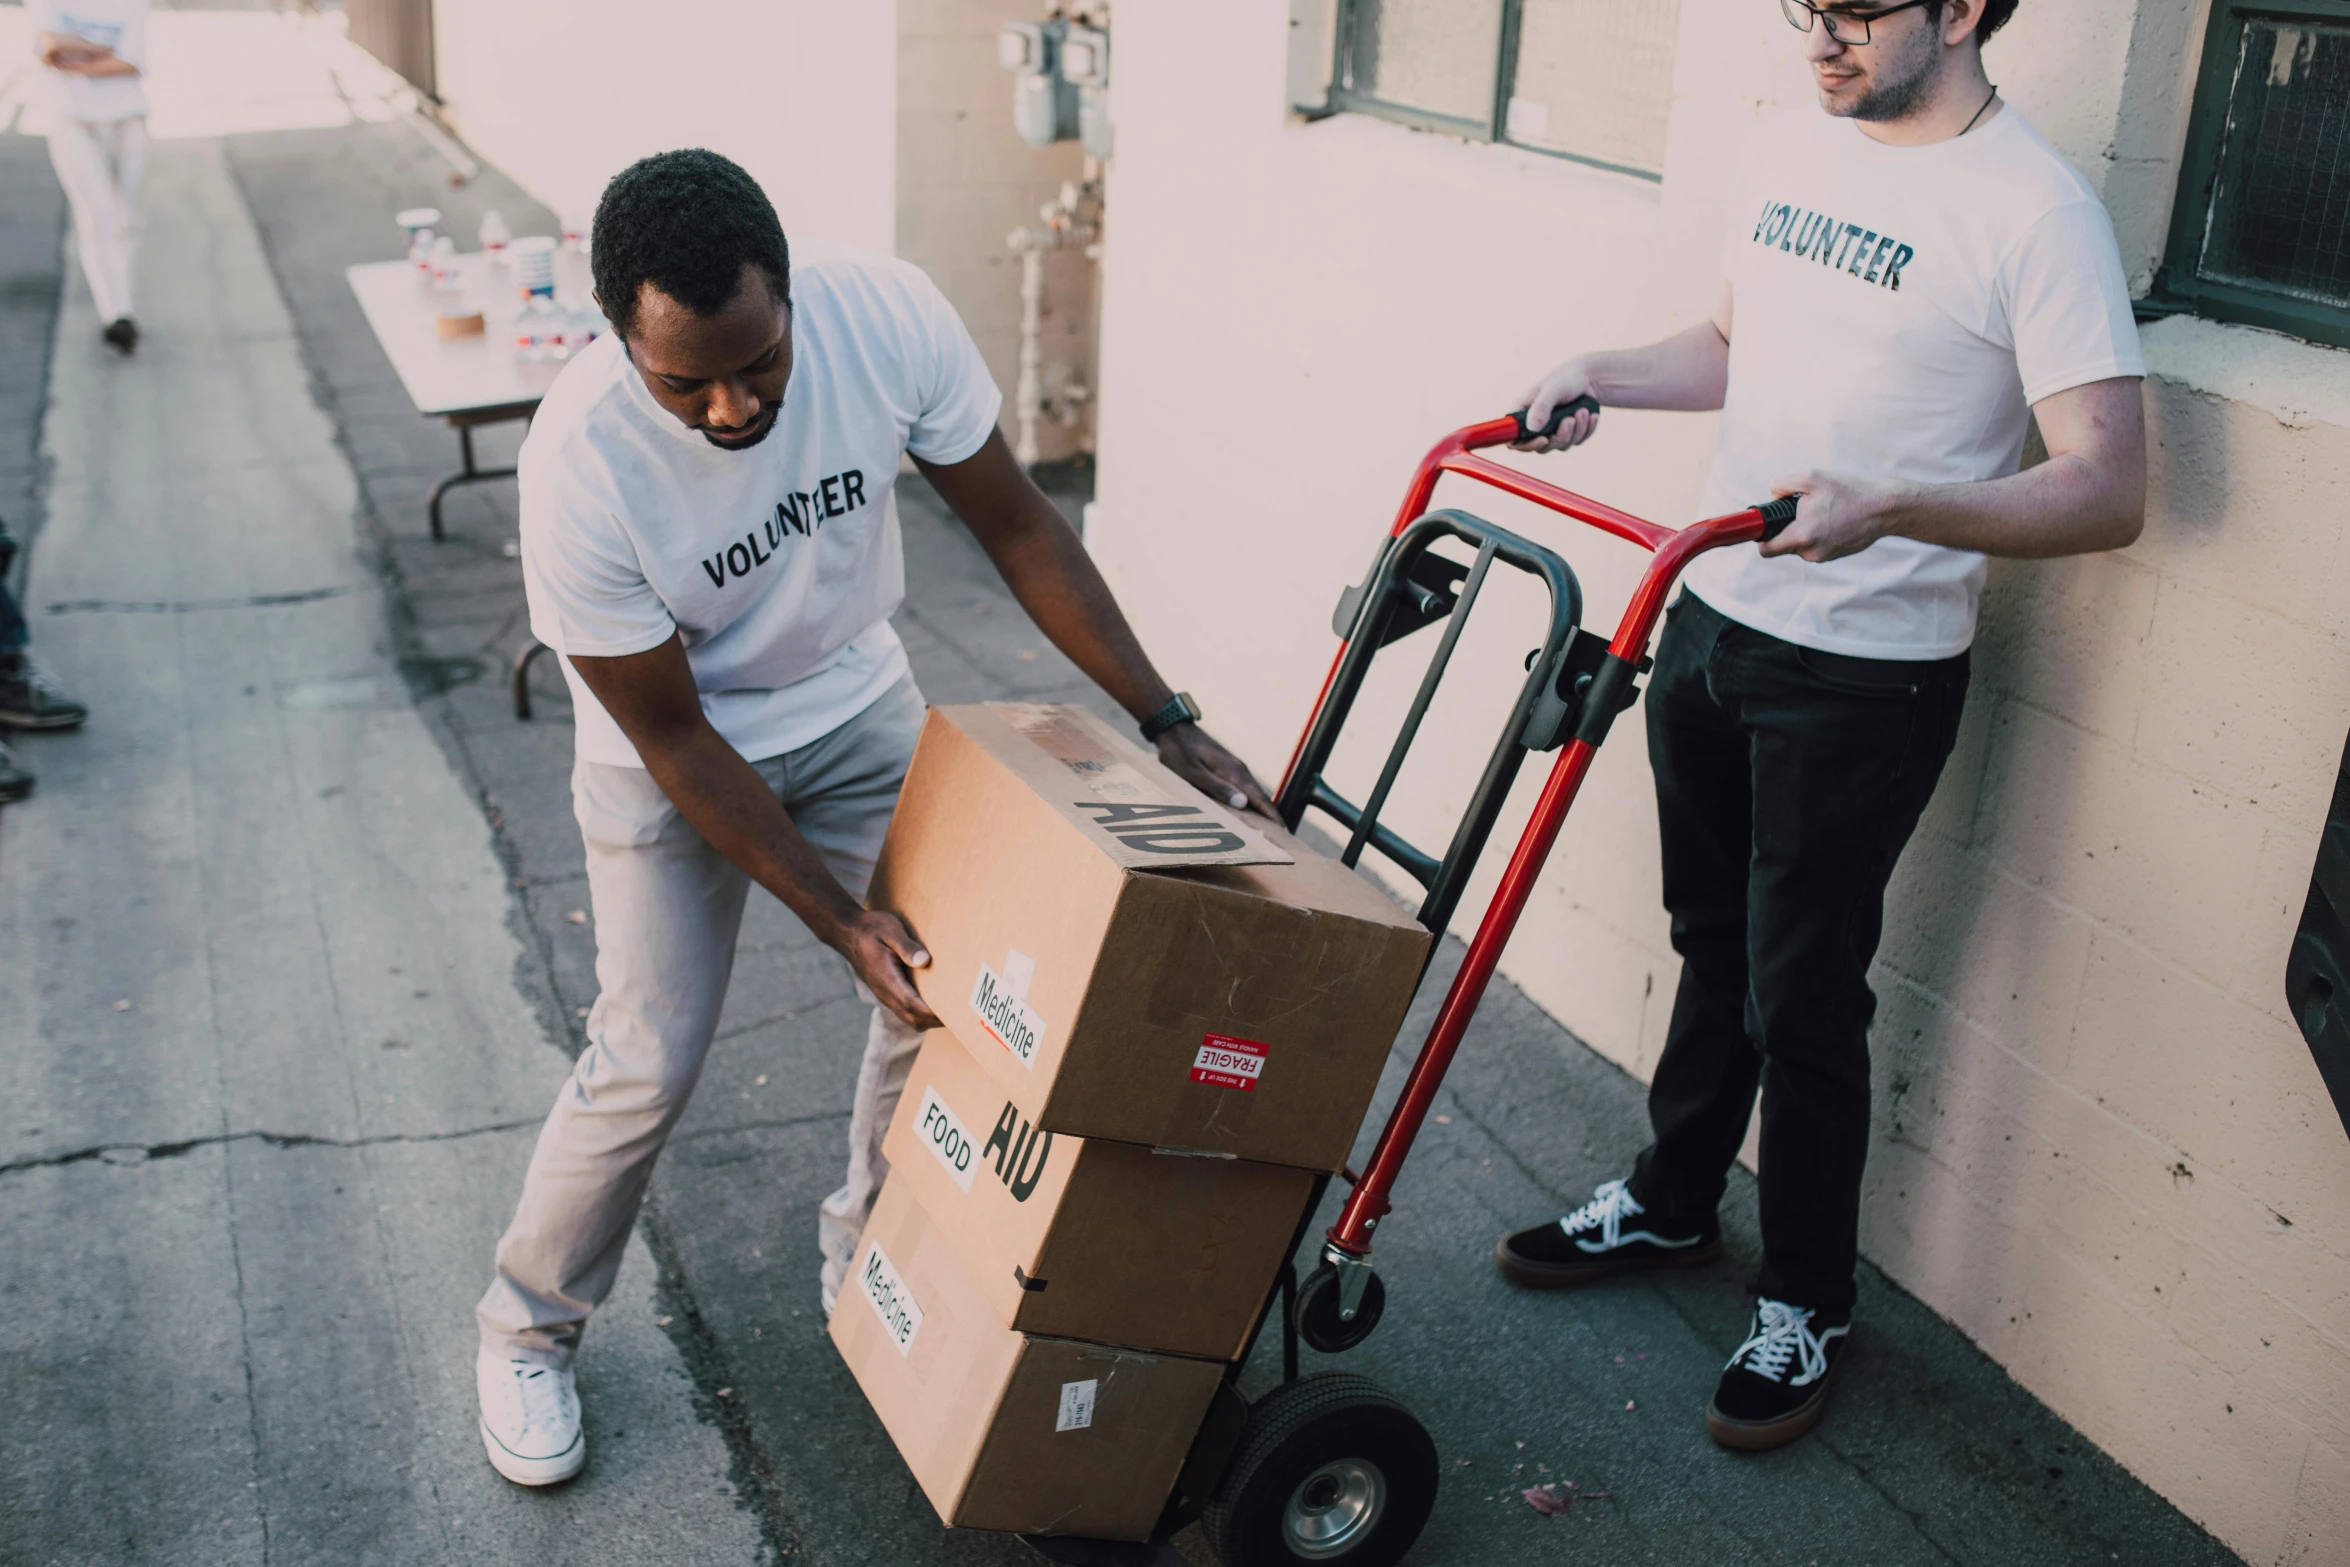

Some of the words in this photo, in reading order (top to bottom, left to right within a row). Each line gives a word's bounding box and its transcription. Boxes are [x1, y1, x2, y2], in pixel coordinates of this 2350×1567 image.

[1753, 200, 1914, 291] VOLUNTEER
[702, 469, 866, 589] VOLUNTEER
[1073, 802, 1246, 854] AID
[975, 972, 1034, 1059] Medicine
[1212, 1039, 1226, 1047] CARE
[1201, 1050, 1258, 1073] FRAGILE
[1216, 1075, 1227, 1083] SIDE
[1239, 1044, 1259, 1053] HANDLE
[1226, 1077, 1238, 1085] THIS
[923, 1102, 971, 1172] FOOD
[982, 1100, 1053, 1203] AID
[862, 1251, 912, 1344] Medicine
